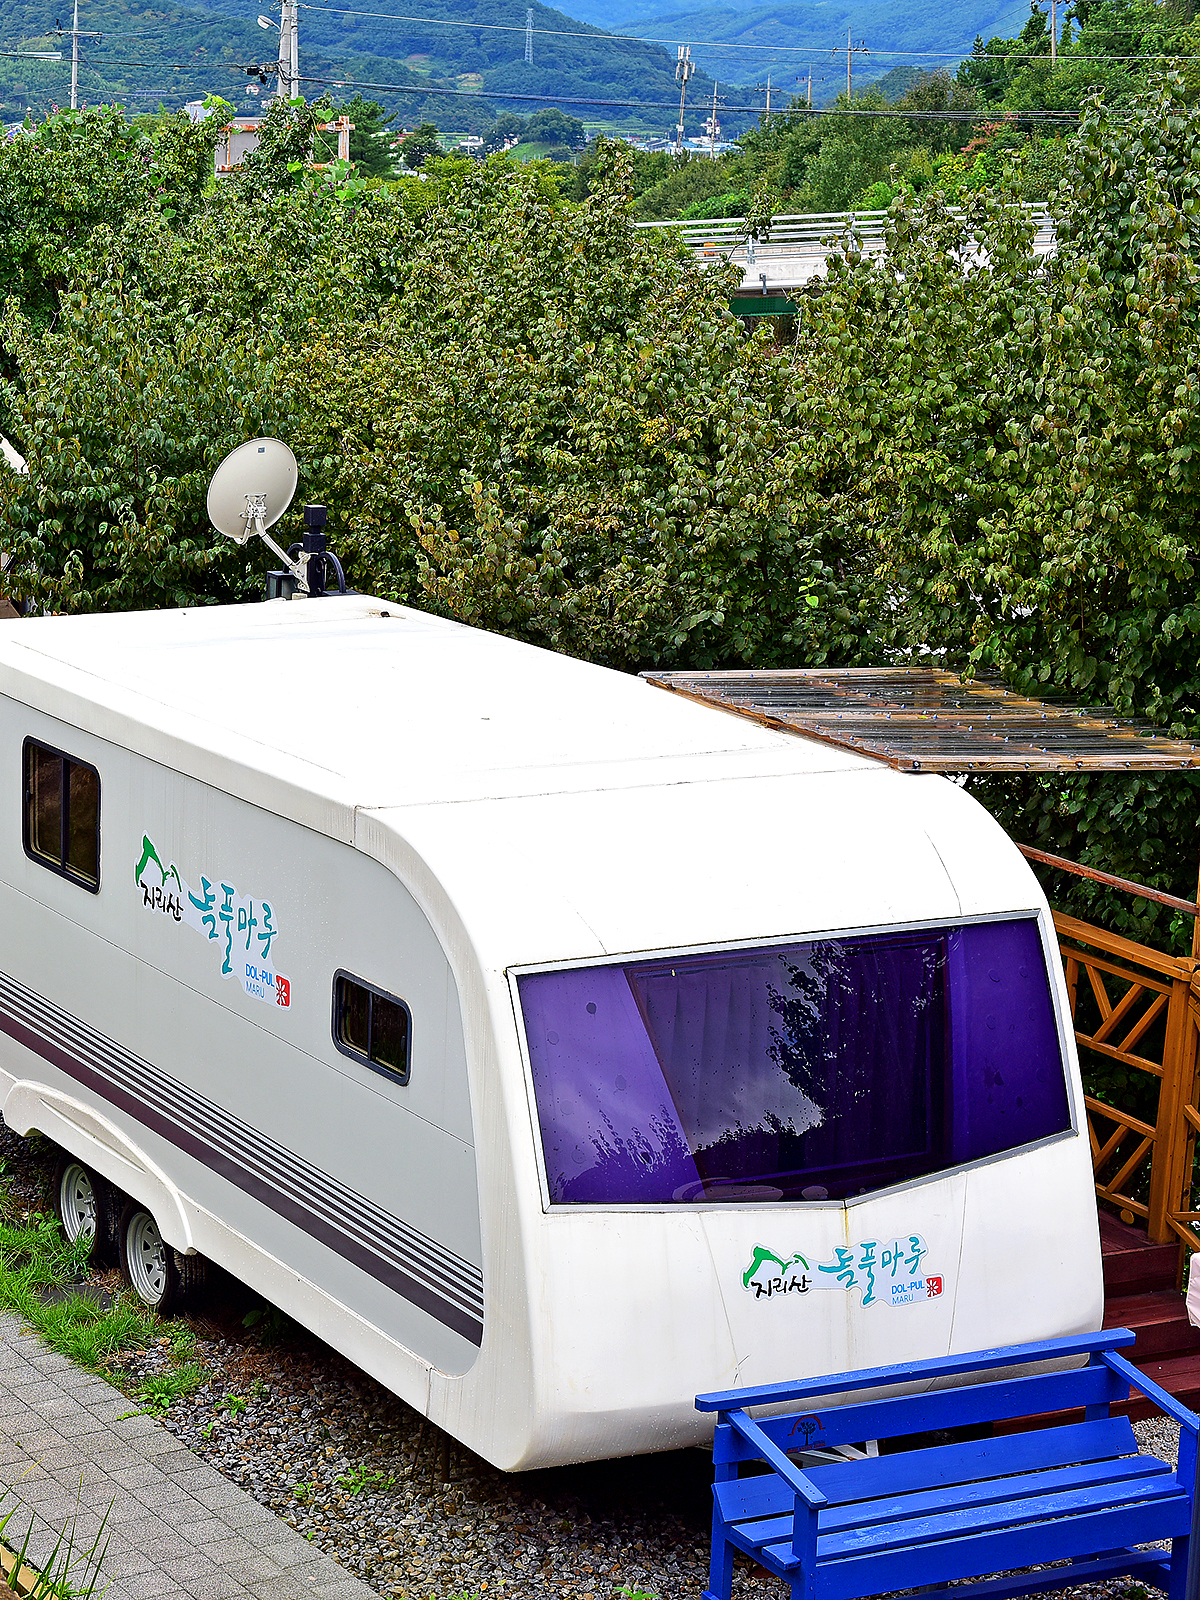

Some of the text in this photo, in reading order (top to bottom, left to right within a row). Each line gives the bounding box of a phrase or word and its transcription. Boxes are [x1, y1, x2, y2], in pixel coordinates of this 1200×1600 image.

[140, 876, 277, 974] 지리산 돌풀마루
[245, 963, 275, 988] DOL-PUL
[245, 980, 265, 999] MARU
[751, 1236, 927, 1305] 지리산 돌풀마루
[891, 1280, 926, 1295] DOL-PUL
[892, 1293, 914, 1305] MARU
